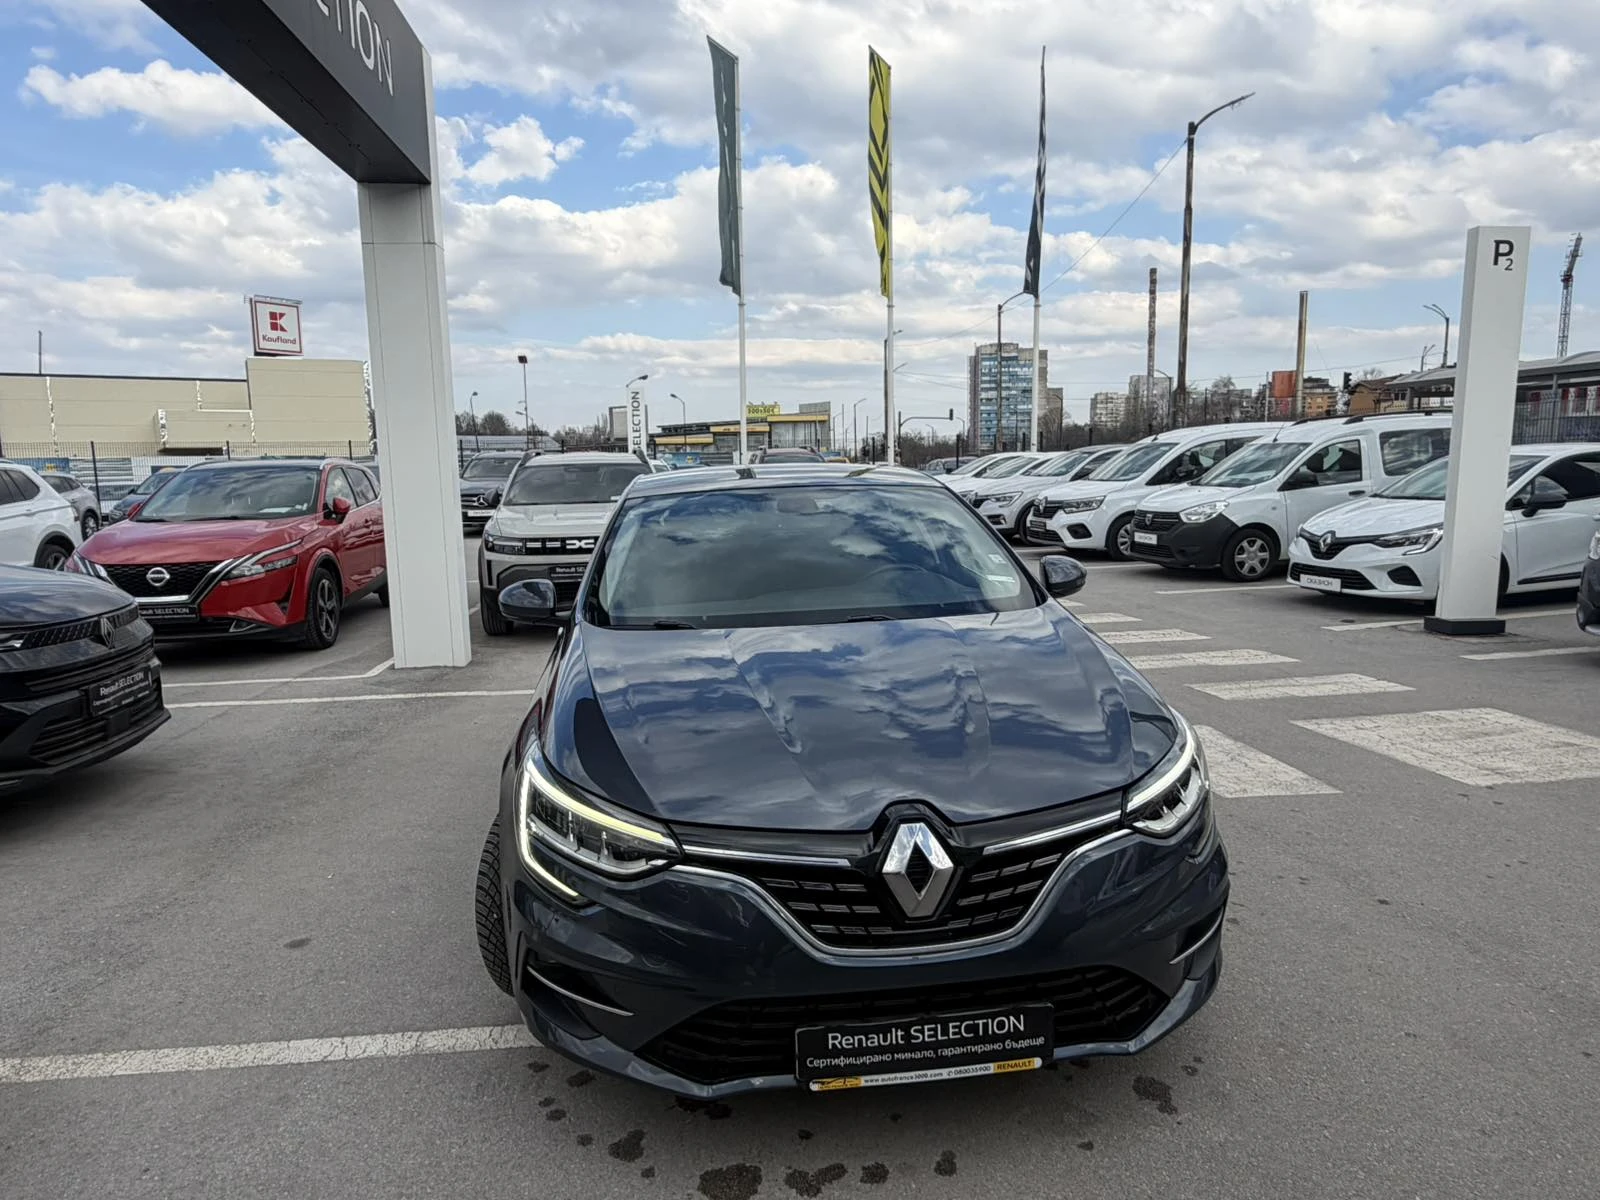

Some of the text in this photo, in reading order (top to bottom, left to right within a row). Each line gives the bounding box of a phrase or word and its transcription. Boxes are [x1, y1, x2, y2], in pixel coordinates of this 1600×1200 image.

[262, 334, 297, 345] Kaufland
[631, 391, 641, 449] ELECTION
[100, 682, 119, 696] Renault
[119, 671, 144, 688] SELECTION
[827, 1014, 1025, 1050] Renault SELECTION
[806, 1036, 1045, 1069] Сертифицирано минало, гарантирано бъдеще
[996, 1060, 1033, 1070] RENAULT
